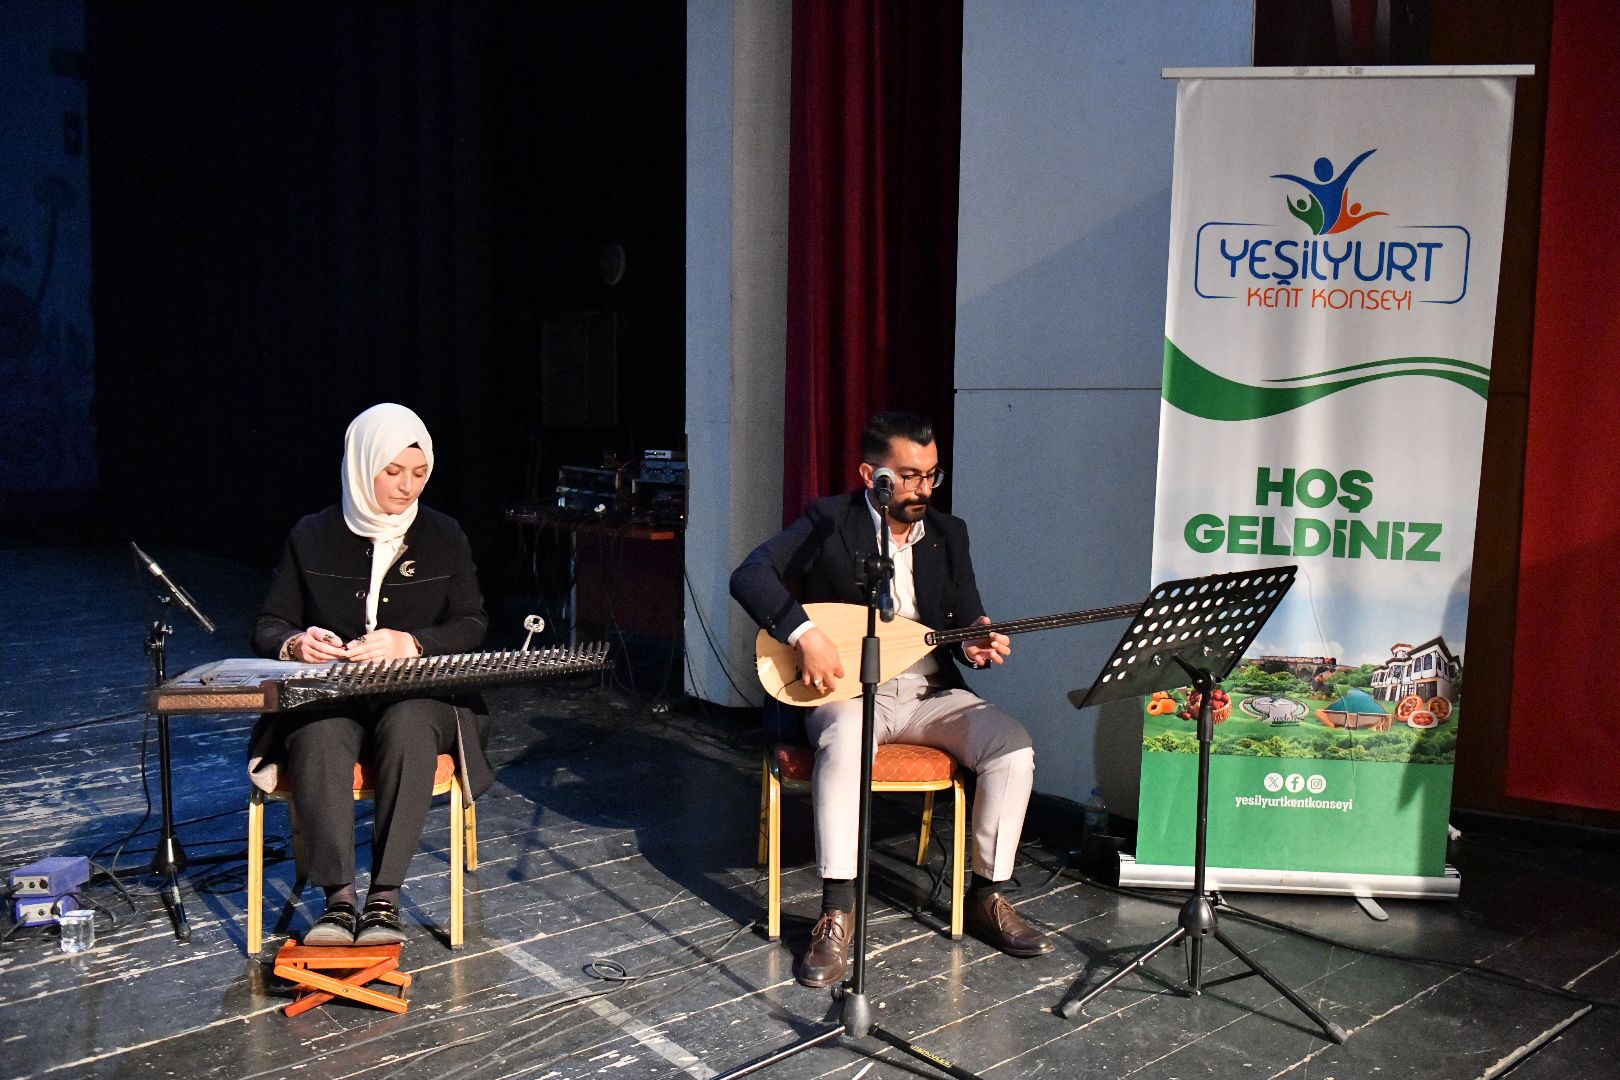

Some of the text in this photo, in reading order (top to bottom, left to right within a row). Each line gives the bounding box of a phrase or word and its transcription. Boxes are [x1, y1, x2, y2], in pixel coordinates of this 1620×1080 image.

[1247, 287, 1303, 308] KENT
[1255, 466, 1374, 514] HOŞ
[1235, 794, 1353, 812] yesilyurtkentkonseyi
